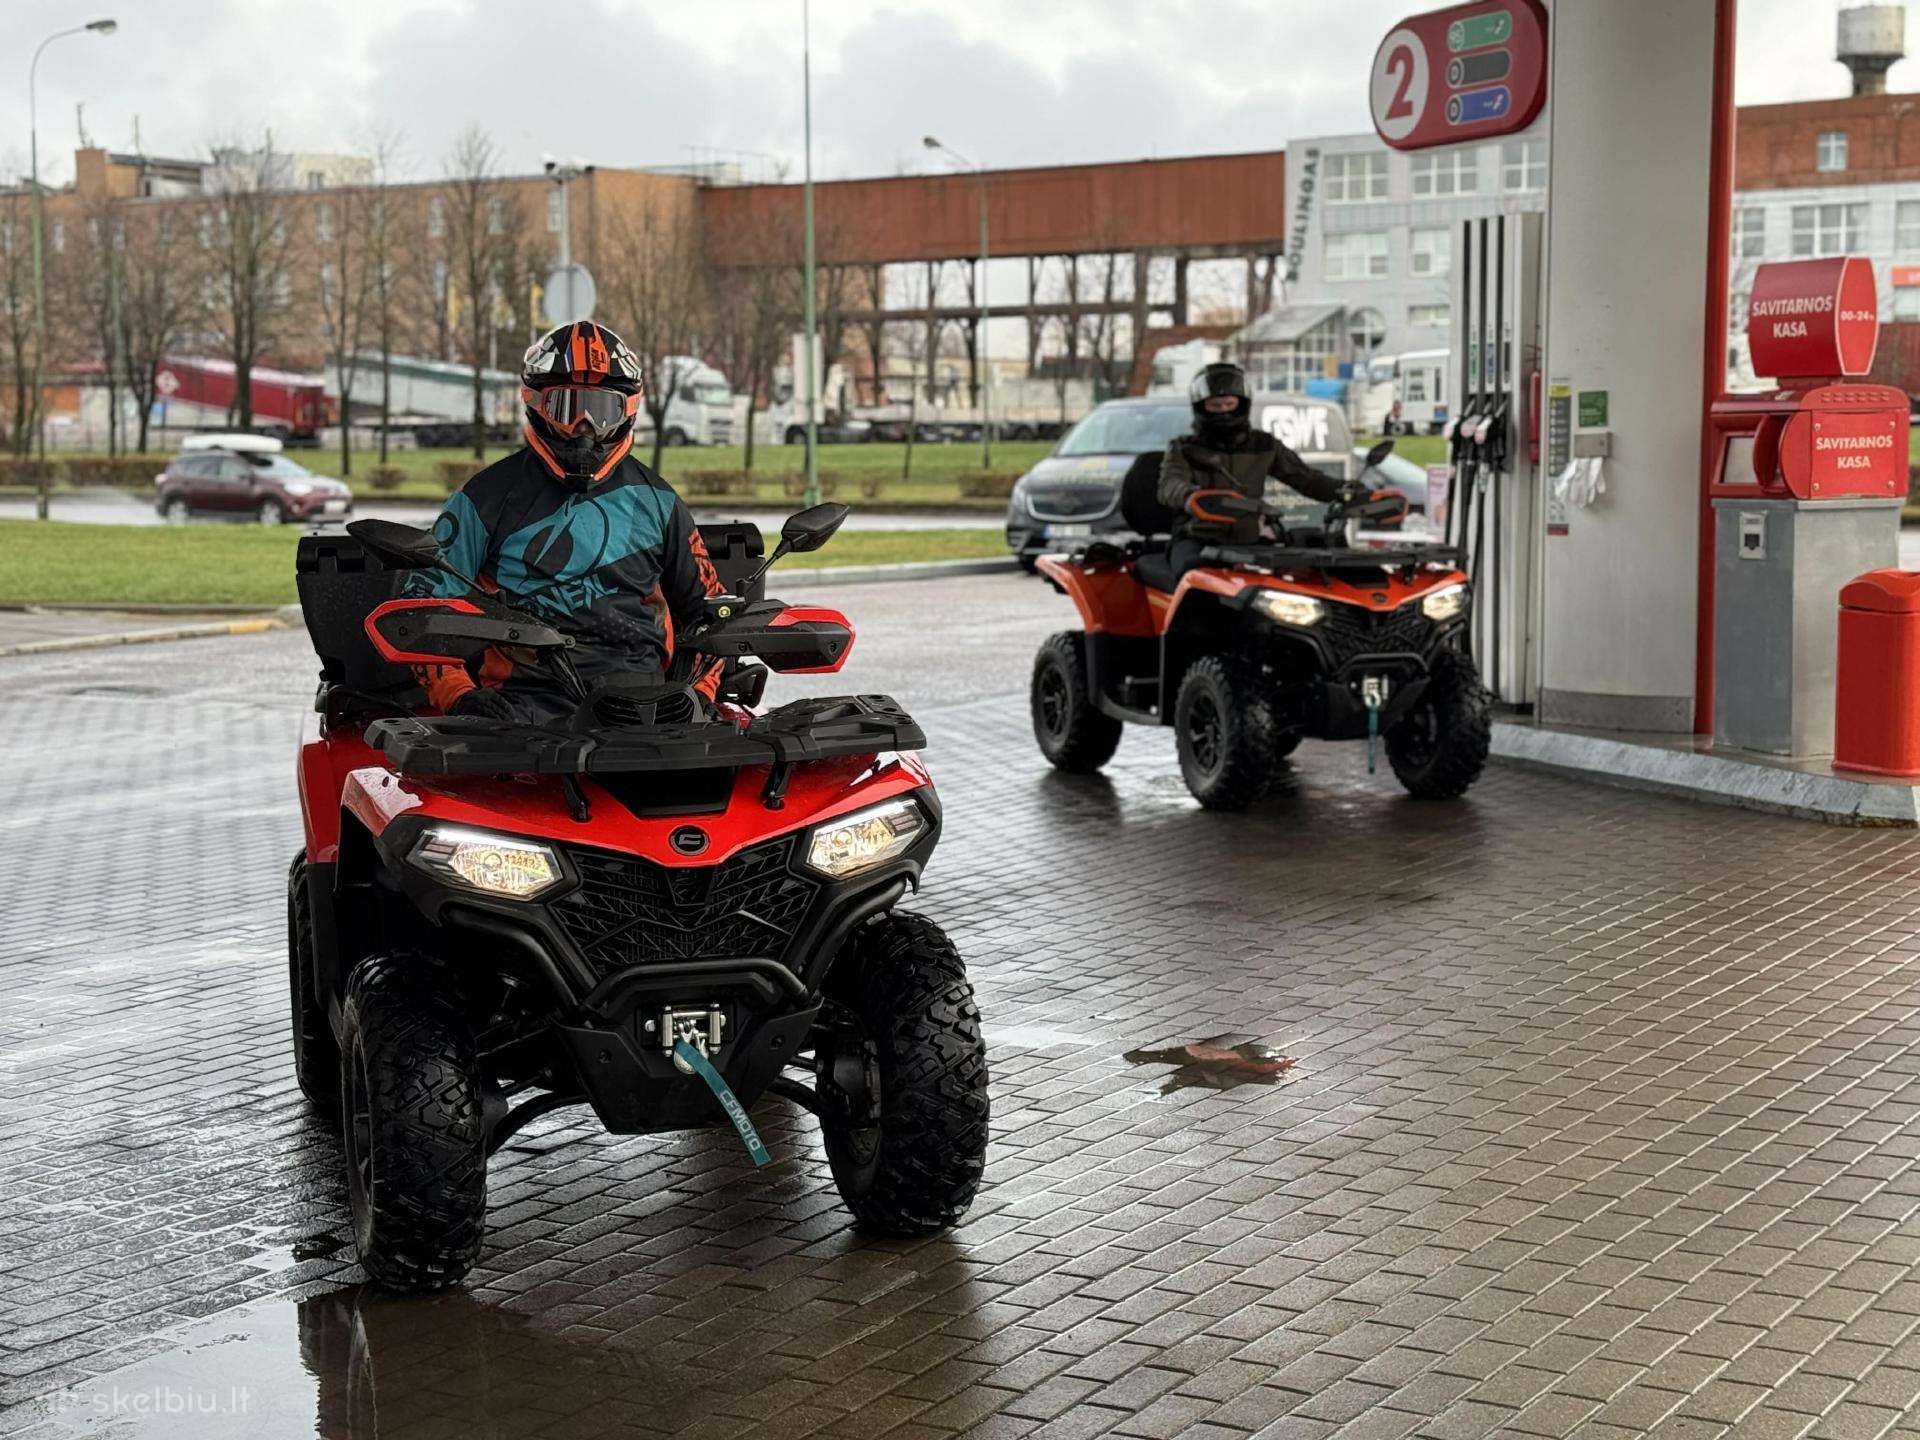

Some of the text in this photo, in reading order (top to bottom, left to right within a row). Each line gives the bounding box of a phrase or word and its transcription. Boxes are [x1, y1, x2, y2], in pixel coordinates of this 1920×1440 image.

[1385, 45, 1415, 121] 2
[1752, 296, 1834, 316] SAVITARNOS
[1773, 321, 1808, 338] KASA
[1816, 435, 1893, 450] SAVITARNOS
[1837, 456, 1872, 469] KASA
[719, 1090, 762, 1151] CFMOTO
